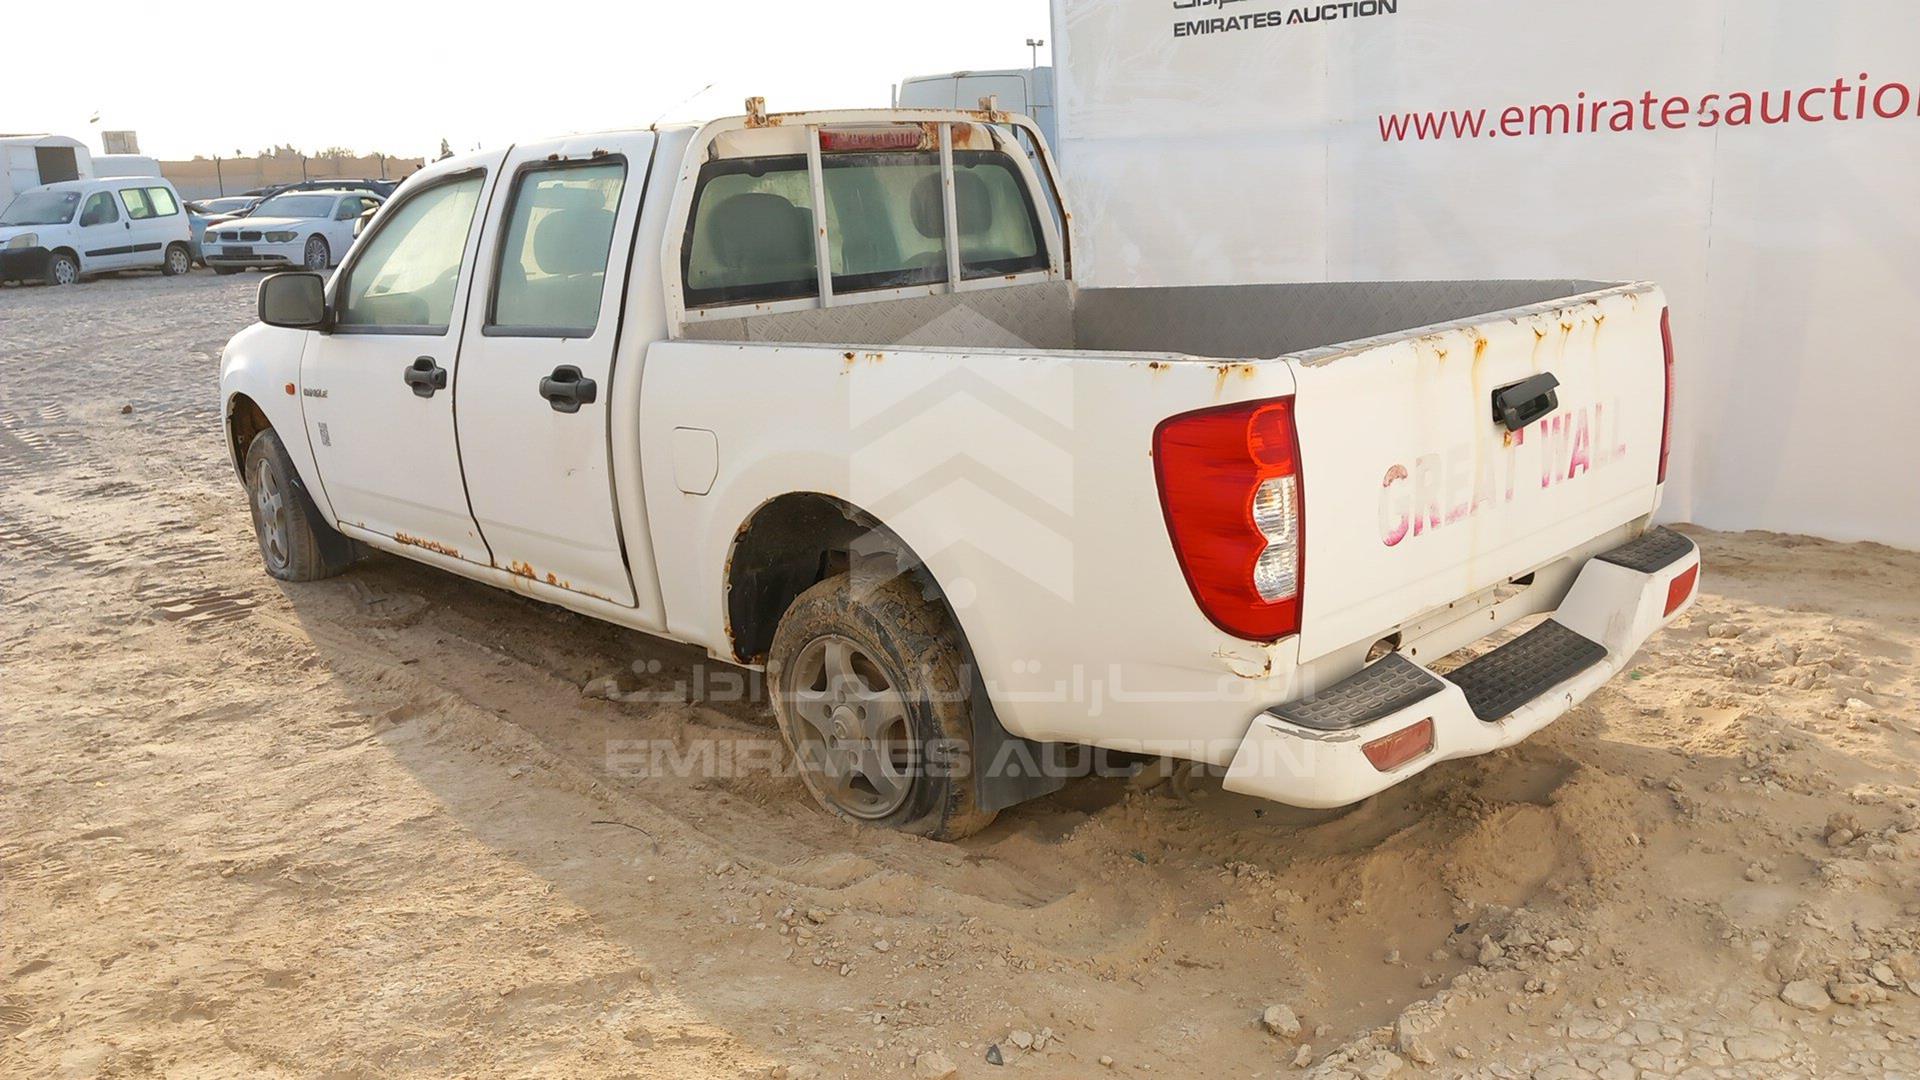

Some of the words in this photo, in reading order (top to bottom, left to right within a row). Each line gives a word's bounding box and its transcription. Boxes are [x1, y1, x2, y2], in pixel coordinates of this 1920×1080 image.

[1173, 10, 1282, 37] EMIRATES
[1286, 0, 1397, 25] AUCTION
[1378, 72, 1920, 142] www.emiratesauctio
